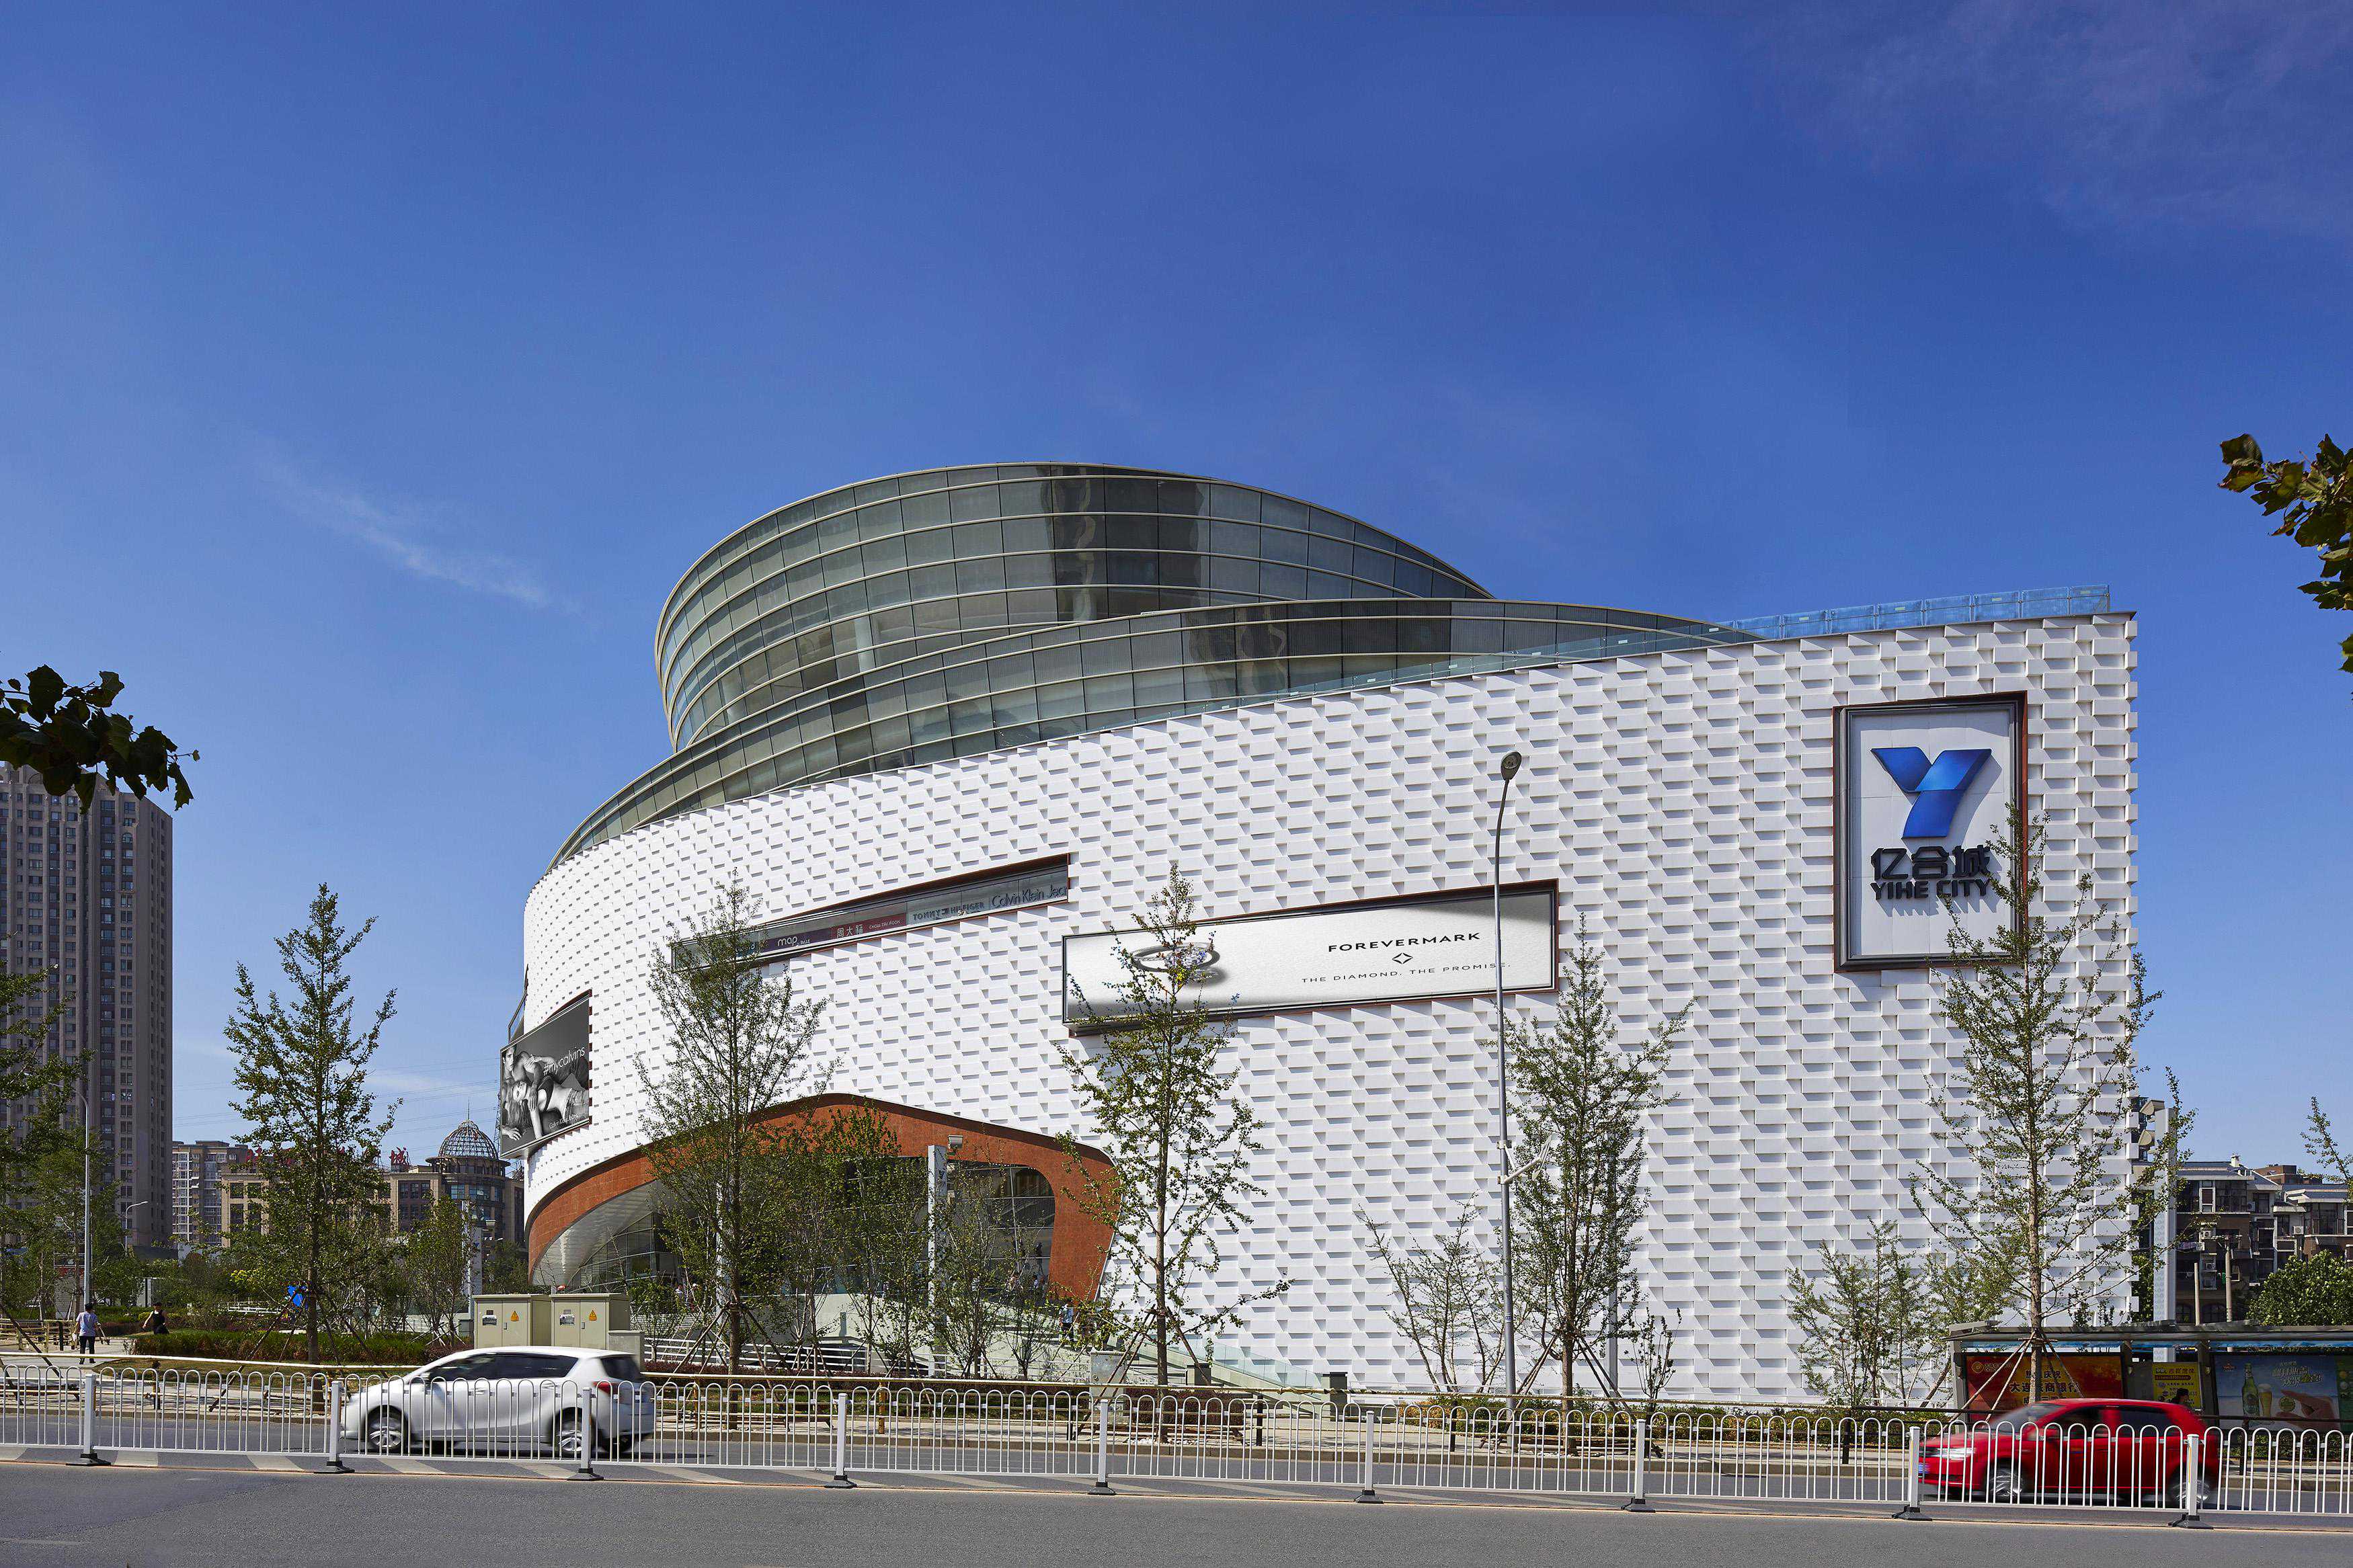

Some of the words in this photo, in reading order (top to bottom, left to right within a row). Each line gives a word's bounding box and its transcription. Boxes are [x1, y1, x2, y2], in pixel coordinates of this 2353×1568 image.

[1871, 845, 1991, 880] 亿合城
[1870, 881, 1929, 900] YIHE
[1936, 879, 1991, 897] CITY
[992, 895, 1021, 907] Calvin
[1022, 889, 1044, 903] Klein
[913, 909, 942, 921] TOMMY
[836, 923, 864, 938] 周大福
[777, 936, 798, 946] map
[1328, 932, 1480, 952] FOREVERMARK
[1333, 971, 1402, 981] DIAMOND.
[543, 1046, 585, 1076] #mycalvins
[2026, 1370, 2061, 1378] 热庆祝
[2010, 1382, 2079, 1393] 大连商银行
